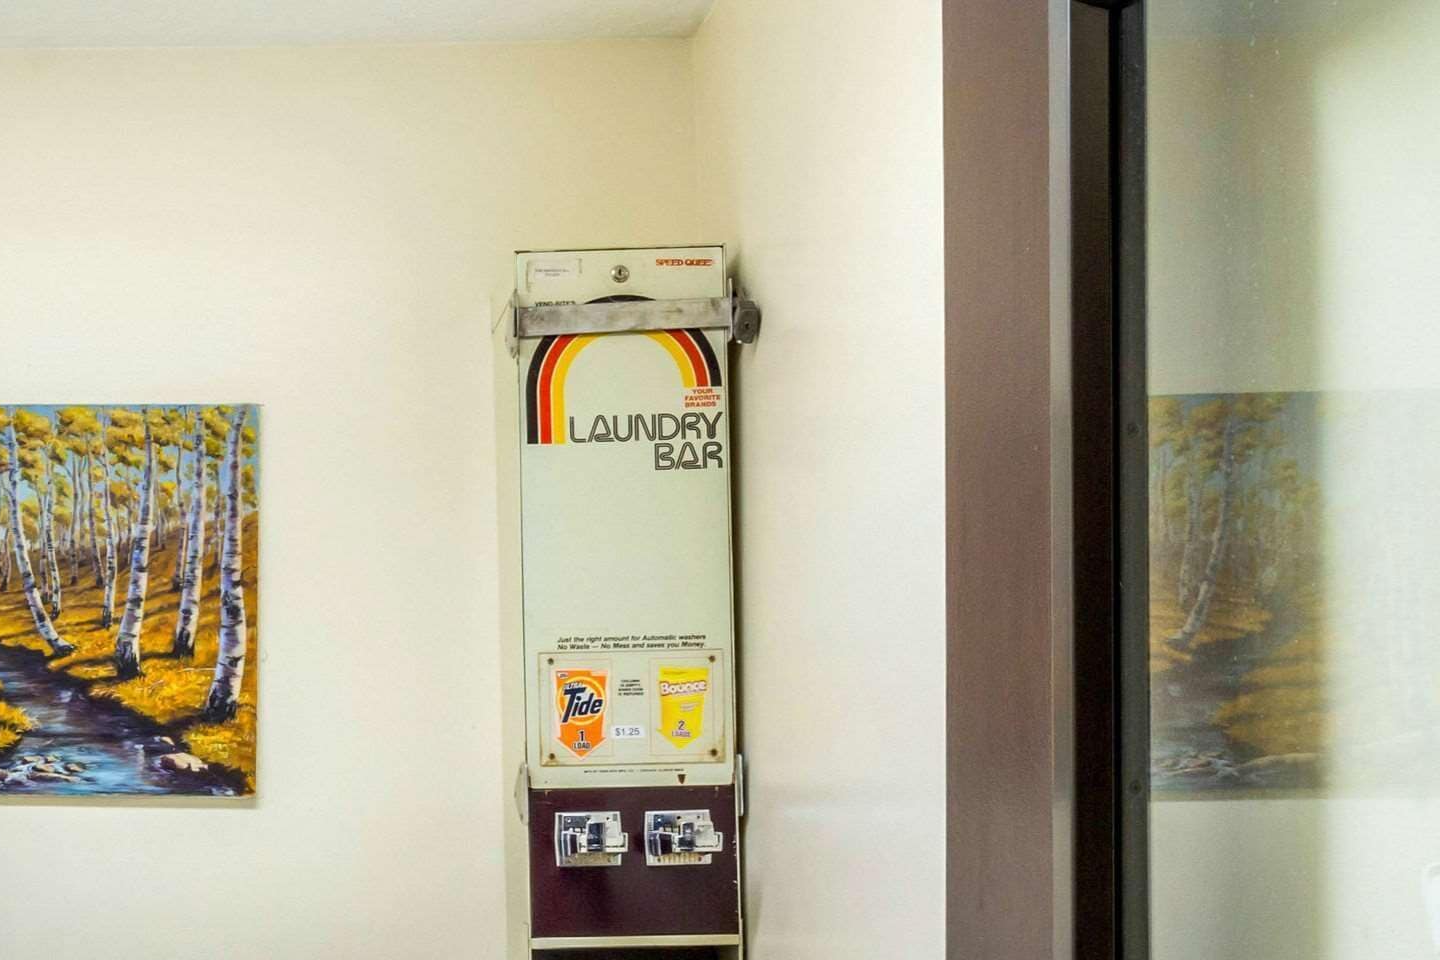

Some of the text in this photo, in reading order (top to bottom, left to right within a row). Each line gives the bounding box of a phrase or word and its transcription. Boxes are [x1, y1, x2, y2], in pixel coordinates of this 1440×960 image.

[656, 258, 714, 267] SPEED QUEE
[569, 411, 723, 443] LAUNDRY
[655, 441, 723, 470] BAR
[659, 680, 707, 696] Bounce
[562, 686, 603, 723] Tide
[678, 720, 685, 731] 2
[579, 730, 585, 742] 1
[615, 727, 640, 737] $1.25
[572, 741, 591, 750] LOAD
